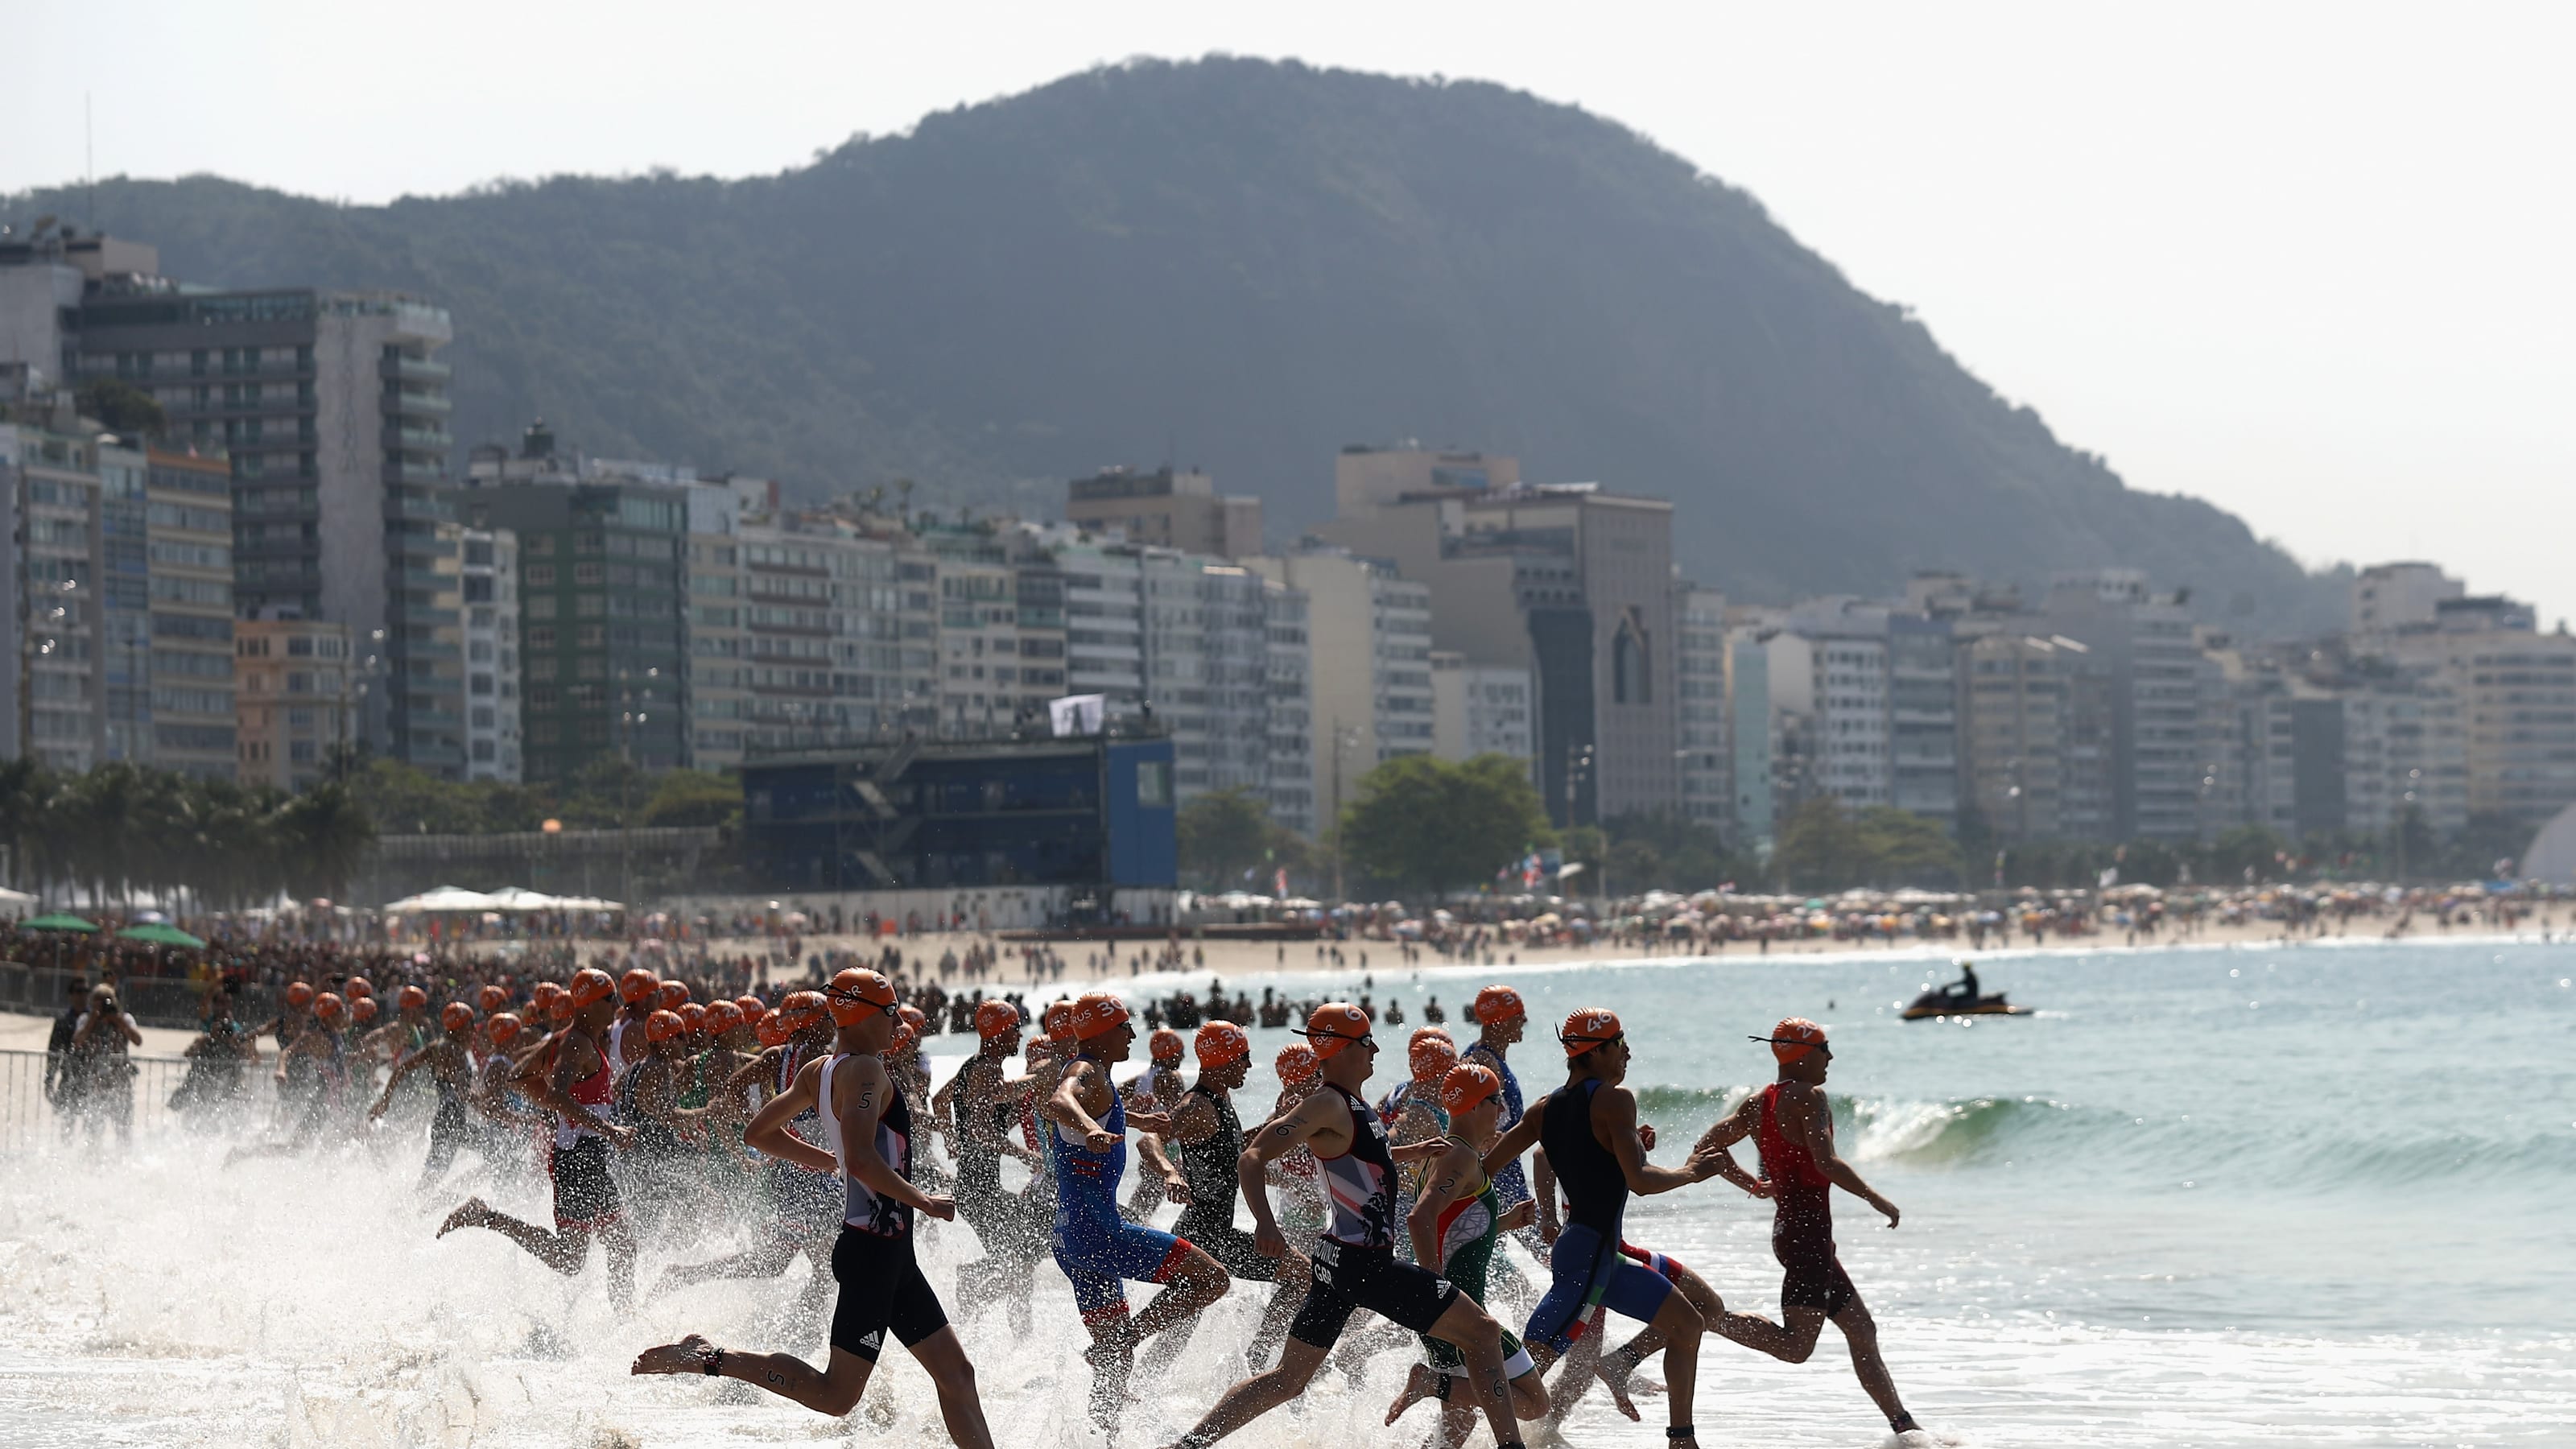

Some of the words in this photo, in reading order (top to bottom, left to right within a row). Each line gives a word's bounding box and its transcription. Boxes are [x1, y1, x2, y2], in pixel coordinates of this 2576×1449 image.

[872, 972, 889, 989] 5
[1096, 997, 1124, 1018] 30
[1344, 1003, 1362, 1022] 6
[1071, 1009, 1092, 1025] RUS
[1587, 1009, 1612, 1033] 46
[1220, 1025, 1245, 1046] 36
[1796, 1020, 1818, 1038] 20
[1197, 1037, 1217, 1050] NZL
[1471, 1068, 1488, 1084] 2
[857, 1091, 873, 1109] 5
[1444, 1086, 1463, 1102] RSA
[1276, 1124, 1297, 1136] 6
[1439, 1178, 1455, 1194] 2
[767, 1369, 785, 1386] 5
[1493, 1378, 1504, 1397] 6
